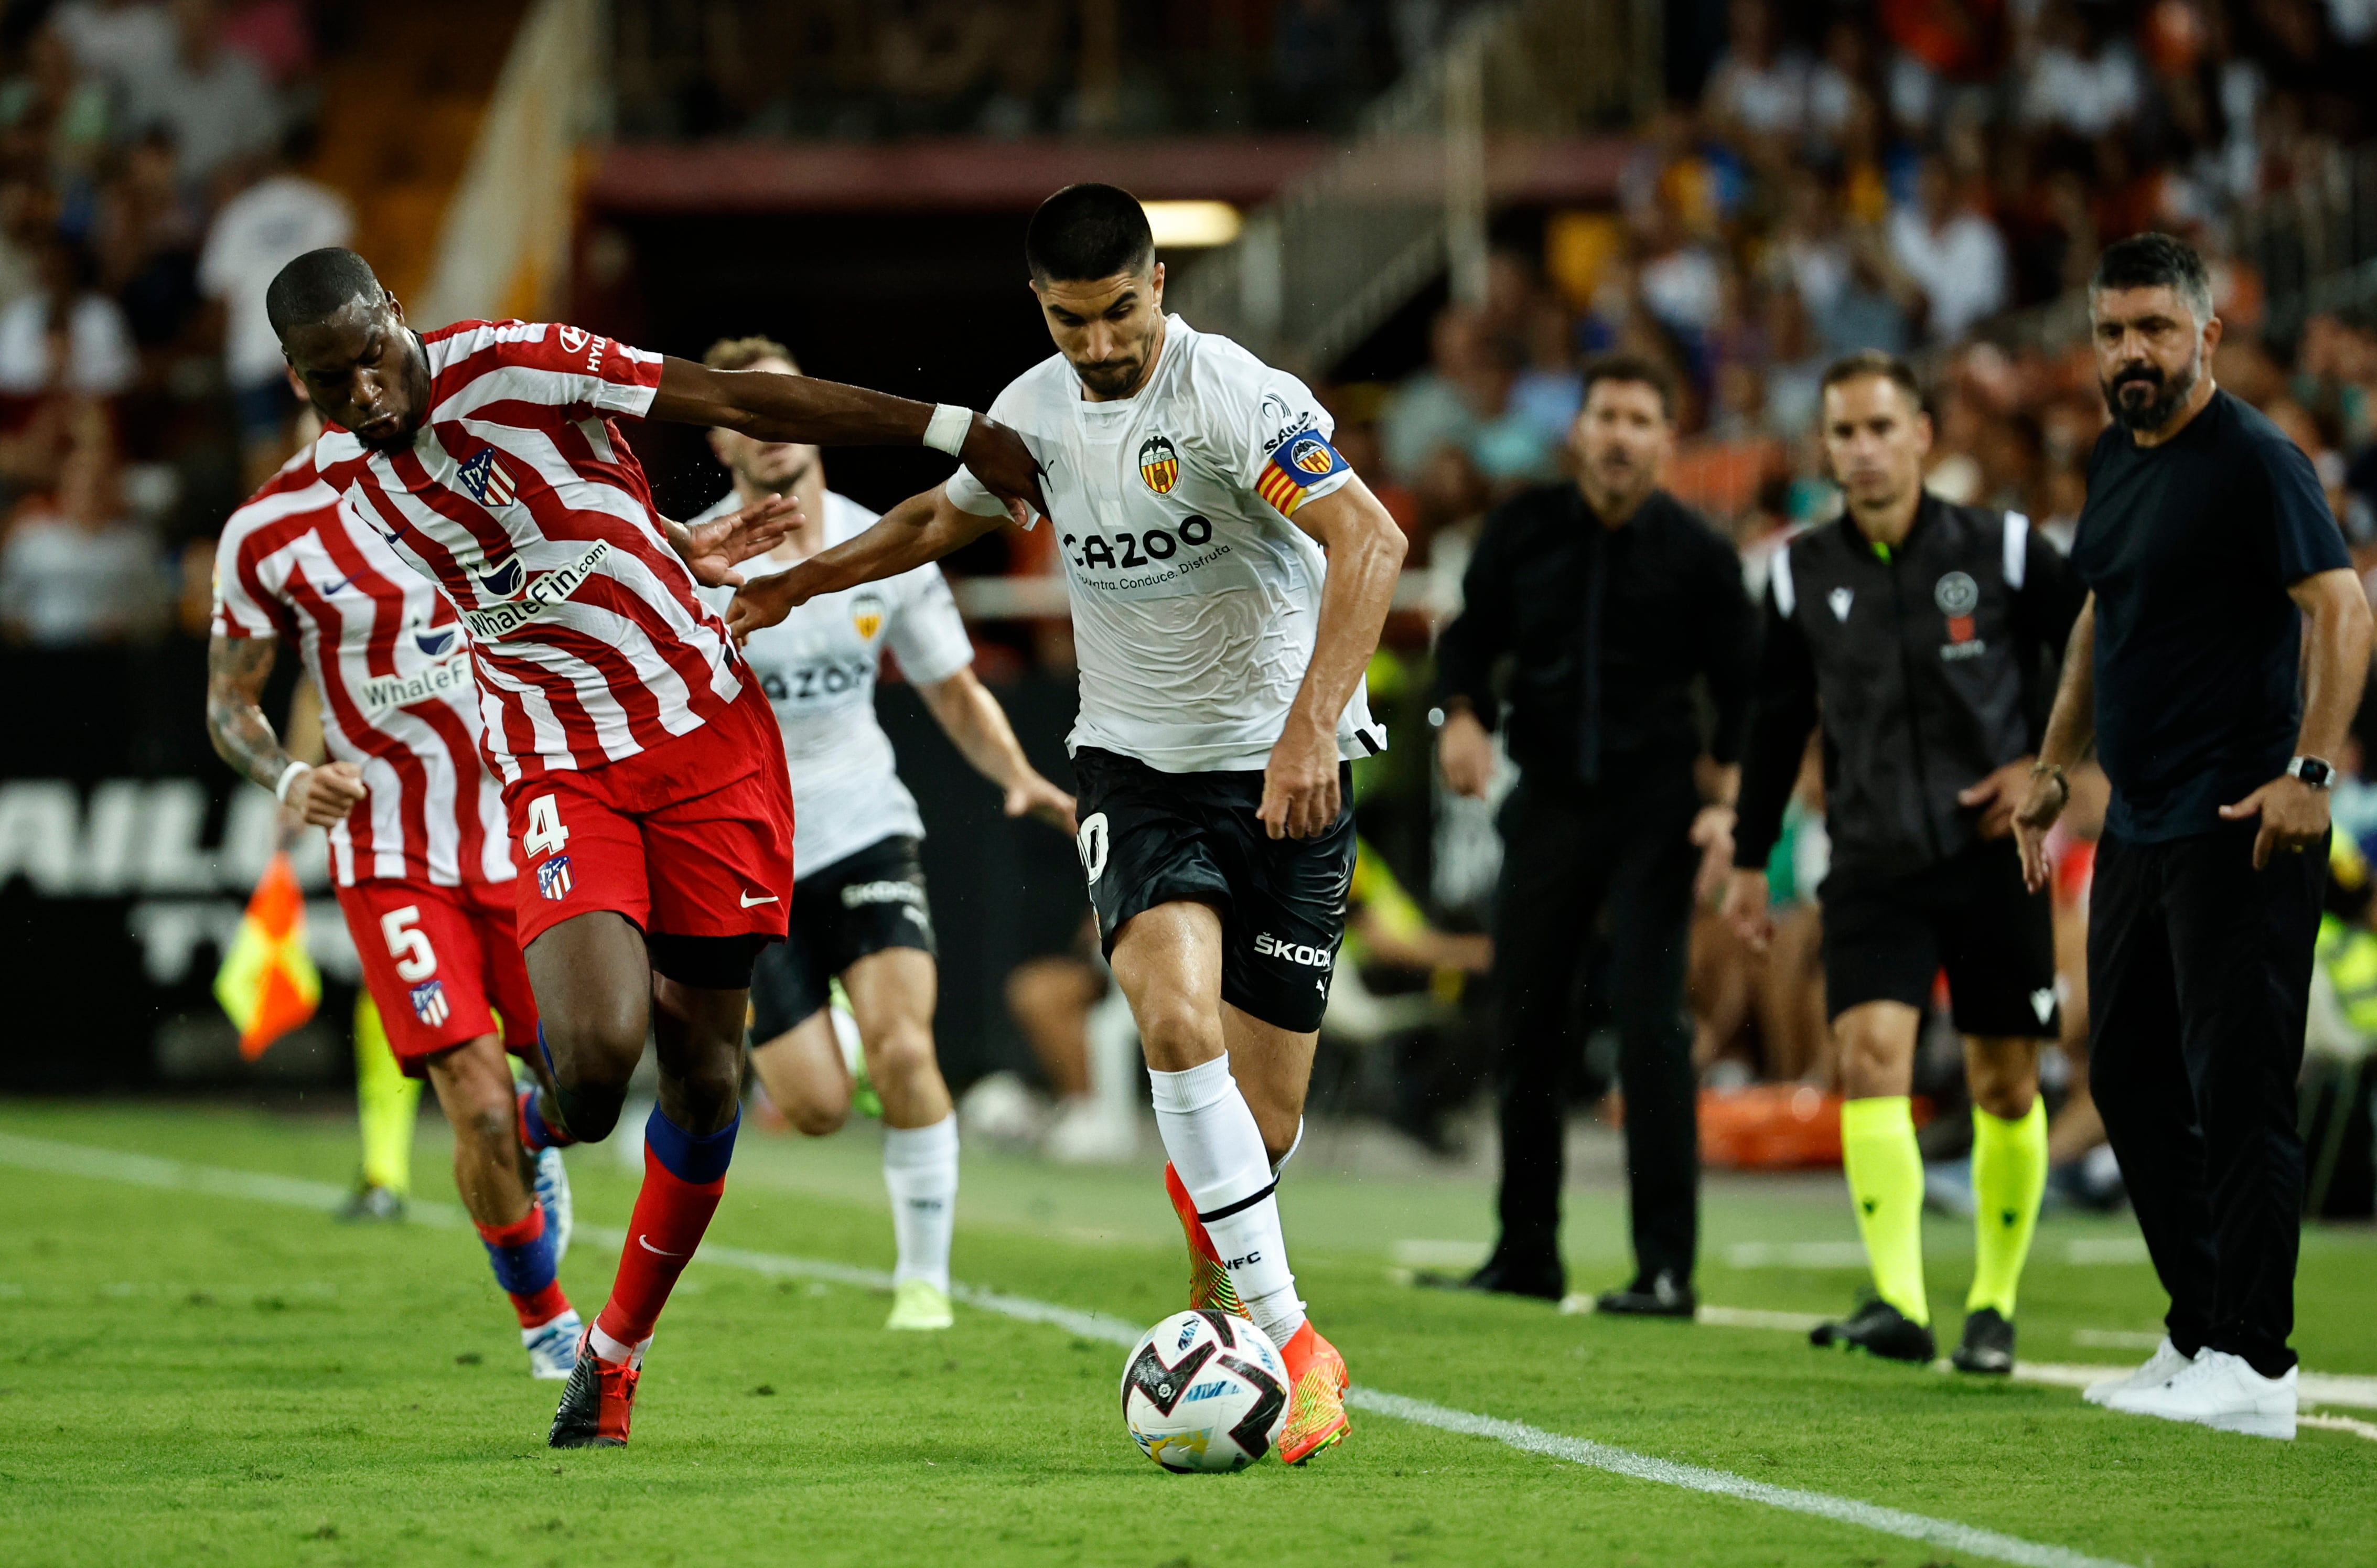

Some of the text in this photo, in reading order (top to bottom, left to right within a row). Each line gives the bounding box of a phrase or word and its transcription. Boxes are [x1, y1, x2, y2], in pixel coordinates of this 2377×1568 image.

[465, 543, 607, 637] WhaleFin.com
[1120, 570, 1178, 590] Conduce.
[1178, 545, 1233, 574] Disfruta.
[523, 793, 569, 859] 4
[380, 905, 437, 983] 5
[1254, 931, 1331, 967] ŠKODA
[1222, 1251, 1261, 1270] VFC
